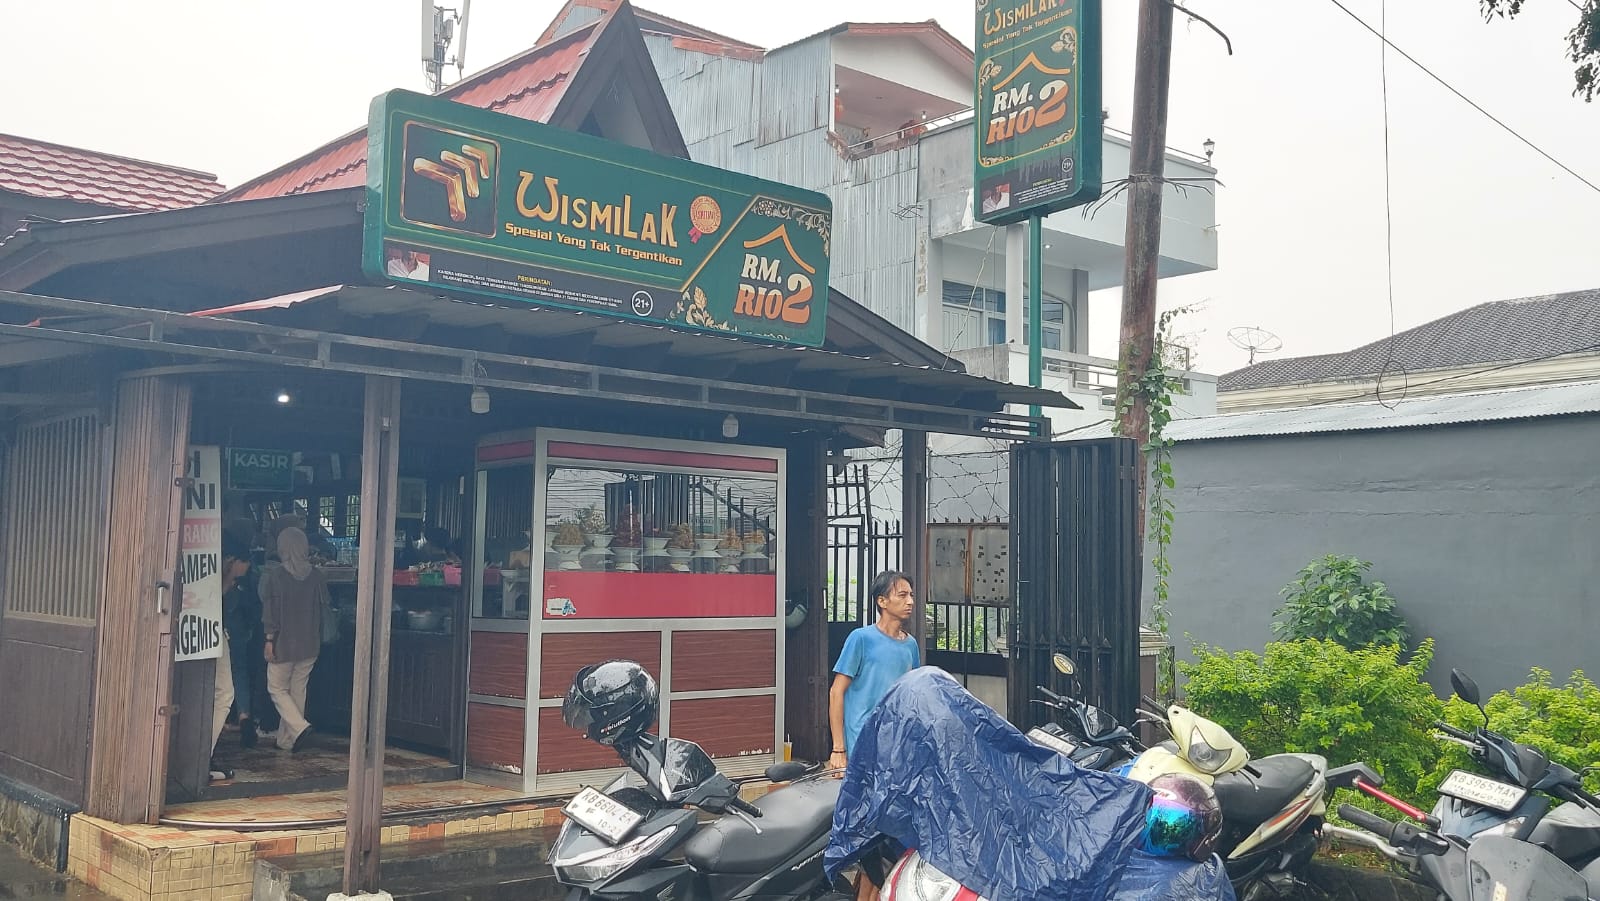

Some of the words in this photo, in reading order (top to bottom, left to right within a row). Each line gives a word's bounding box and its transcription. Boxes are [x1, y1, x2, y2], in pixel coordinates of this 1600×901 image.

[986, 105, 1035, 145] RIO
[1034, 79, 1069, 128] 2
[992, 82, 1033, 115] RM.
[516, 171, 678, 248] WISMILAK
[505, 223, 552, 241] Spesial
[556, 232, 586, 249] Yang
[590, 240, 611, 252] Tak
[615, 244, 682, 266] Tergantikan
[741, 253, 782, 284] RM.
[634, 298, 650, 309] 21+
[734, 283, 783, 320] RIO
[781, 273, 813, 324] 2
[234, 452, 289, 469] KASIR
